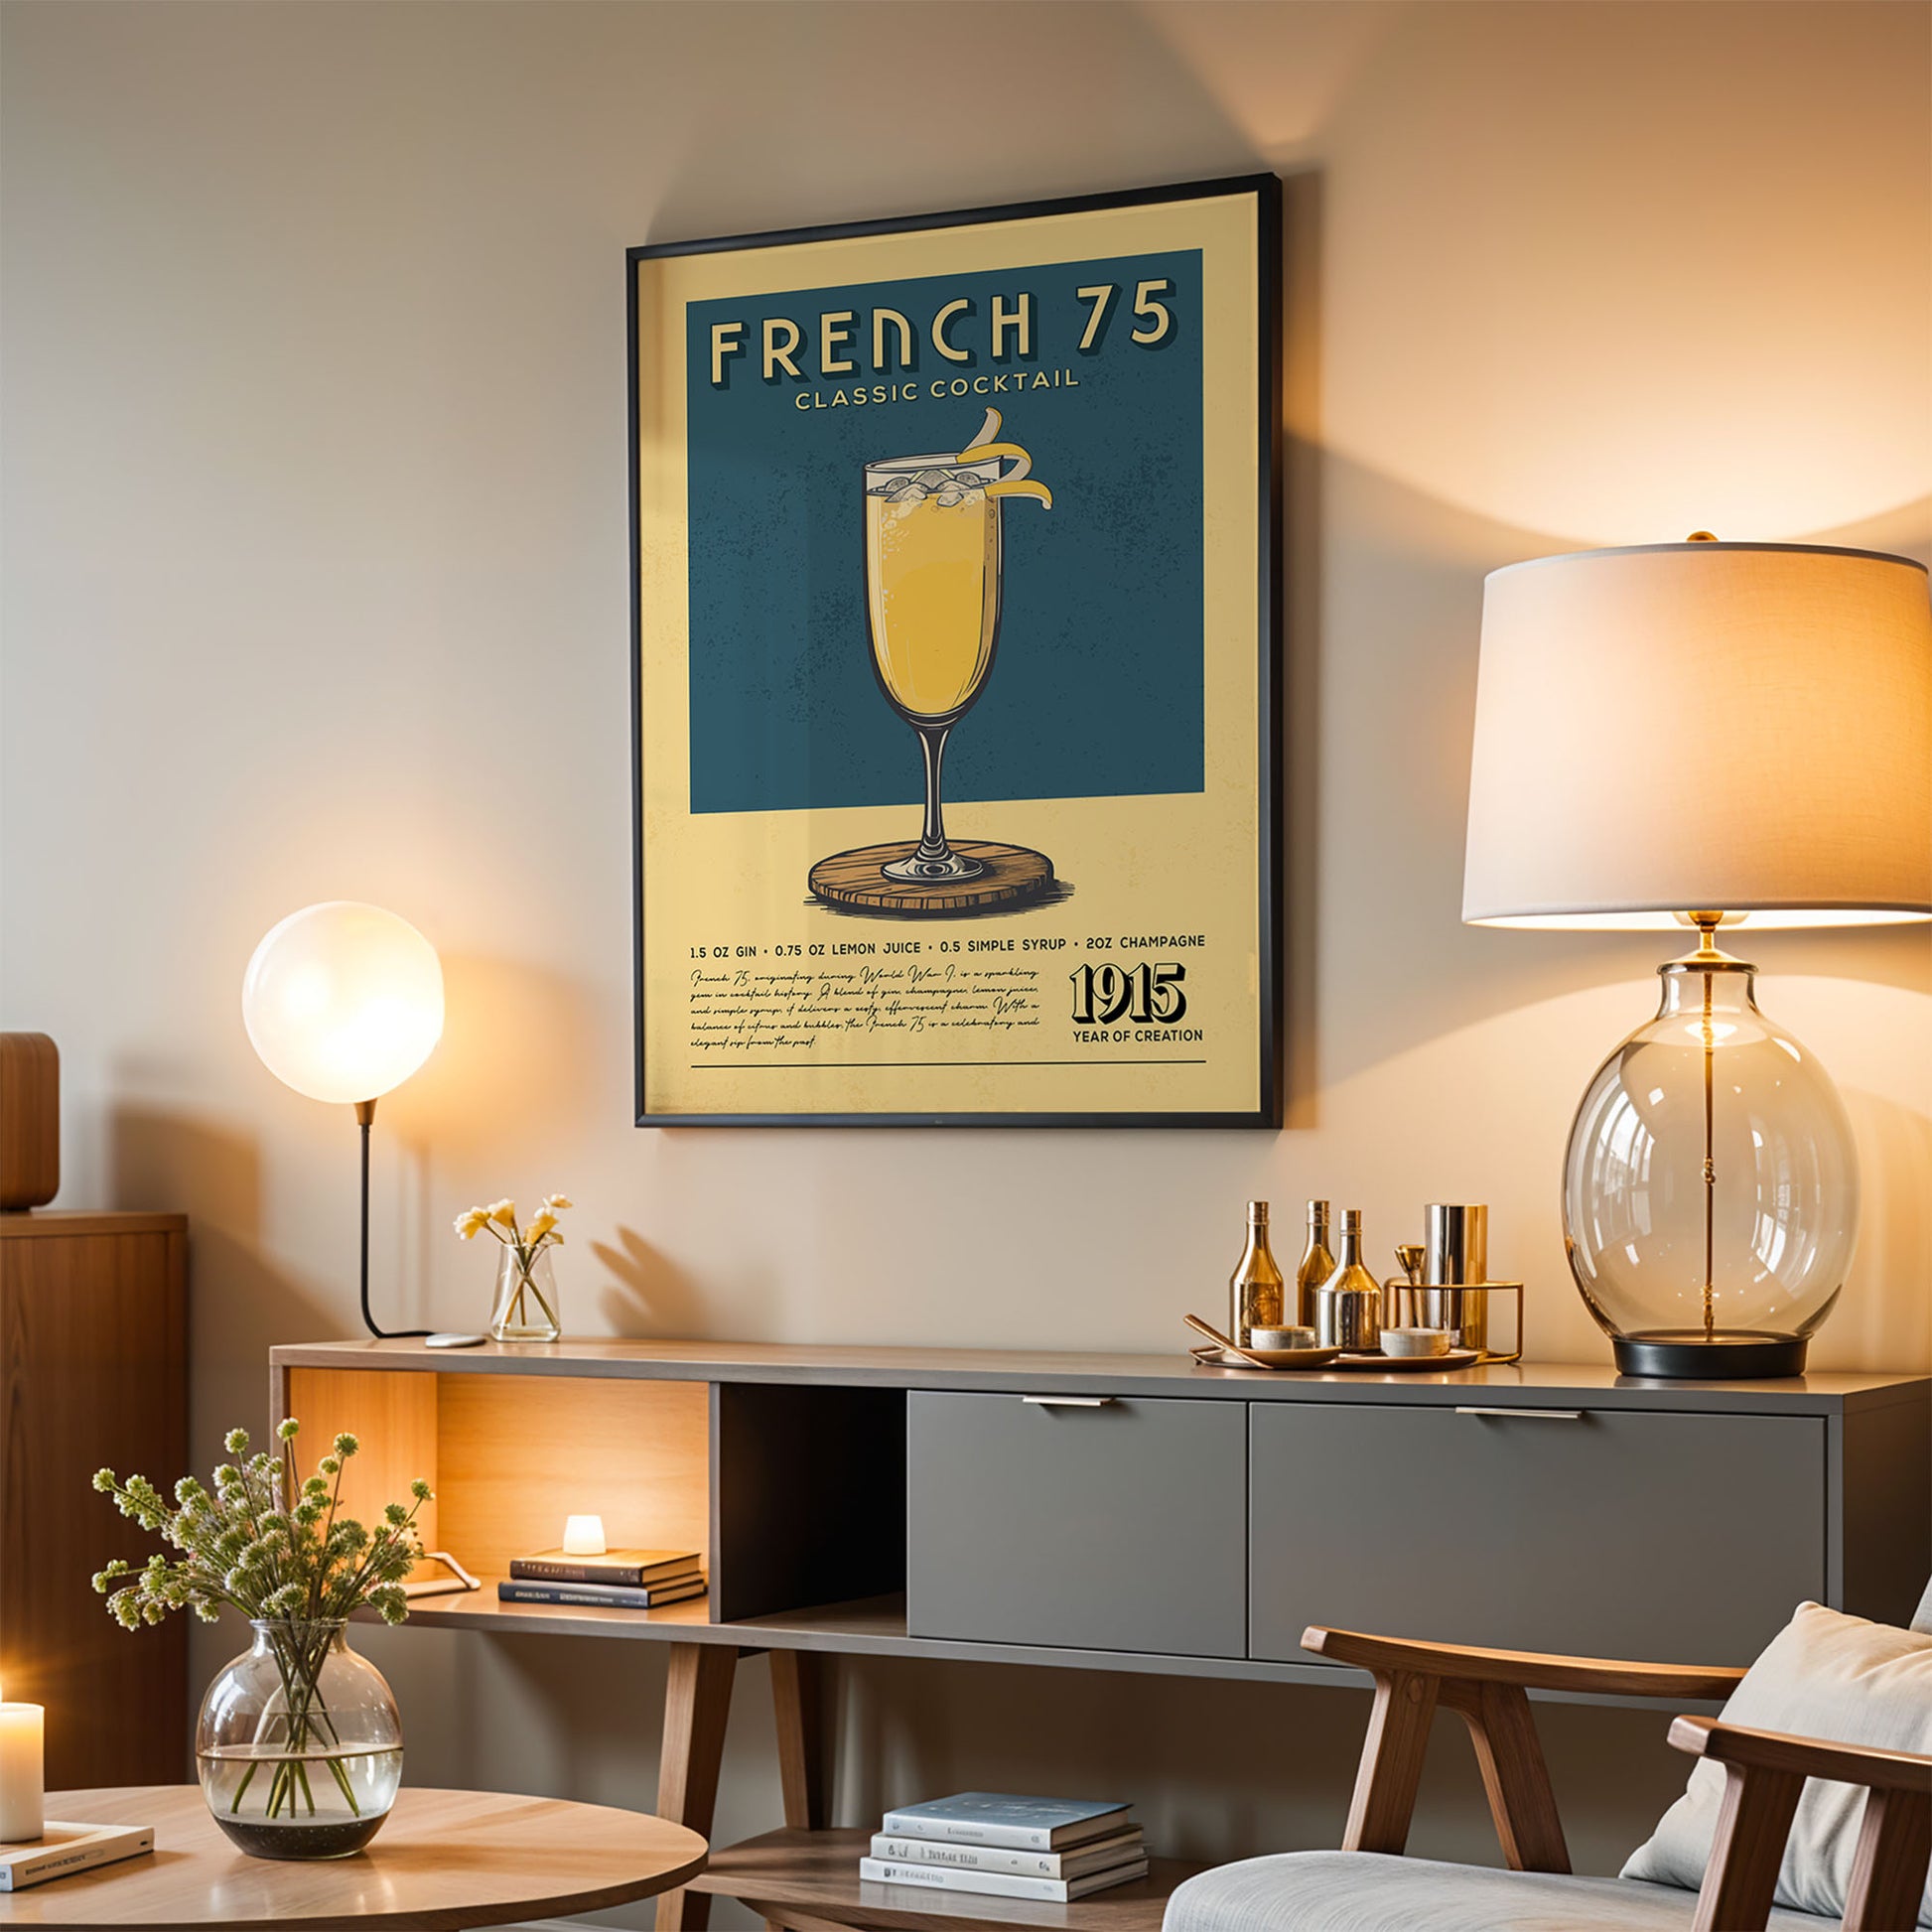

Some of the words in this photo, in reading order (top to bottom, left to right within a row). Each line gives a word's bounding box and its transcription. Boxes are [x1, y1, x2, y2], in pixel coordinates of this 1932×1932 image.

[710, 293, 1035, 388] FRENCH
[1076, 278, 1175, 352] 75
[794, 382, 918, 411] CLASSIC
[929, 368, 1079, 398] COCKTAIL
[690, 947, 707, 959] 1.5
[713, 946, 730, 958] OZ
[736, 946, 757, 957] GIN
[774, 945, 802, 957] 0.75
[808, 944, 825, 956] OZ
[832, 943, 876, 955] LEMON
[883, 941, 921, 954] JUICE
[940, 941, 961, 953] 0.5
[968, 939, 1015, 952] SIMPLE
[1022, 938, 1066, 951] SYRUP
[1086, 937, 1113, 949] 2OZ
[1120, 935, 1205, 949] CHAMPAGNE
[691, 969, 730, 987] French
[755, 971, 814, 984] originating
[818, 972, 856, 983] during
[860, 966, 904, 984] World
[907, 964, 941, 983] War
[985, 968, 1039, 980] sparkling
[690, 993, 713, 1003] gem
[730, 988, 771, 1001] cocktail
[834, 987, 864, 996] blend
[867, 984, 879, 999] of
[972, 985, 1007, 994] lemon
[1069, 962, 1187, 1025] 1915
[713, 1006, 748, 1016] simple
[786, 1003, 795, 1016] it
[886, 1000, 948, 1015] effervescent
[993, 996, 1028, 1015] With
[734, 1020, 745, 1034] of
[748, 1020, 777, 1033] citrus
[845, 1018, 864, 1032] the
[866, 1015, 907, 1033] French
[909, 1016, 926, 1033] 75
[951, 1016, 1015, 1030] celebratory
[1018, 1017, 1040, 1026] and
[690, 1036, 729, 1050] elegant
[747, 1035, 774, 1049] from
[774, 1035, 792, 1048] the
[1073, 1031, 1109, 1042] YEAR
[1113, 1030, 1131, 1041] OF
[1135, 1030, 1203, 1041] CREATION
